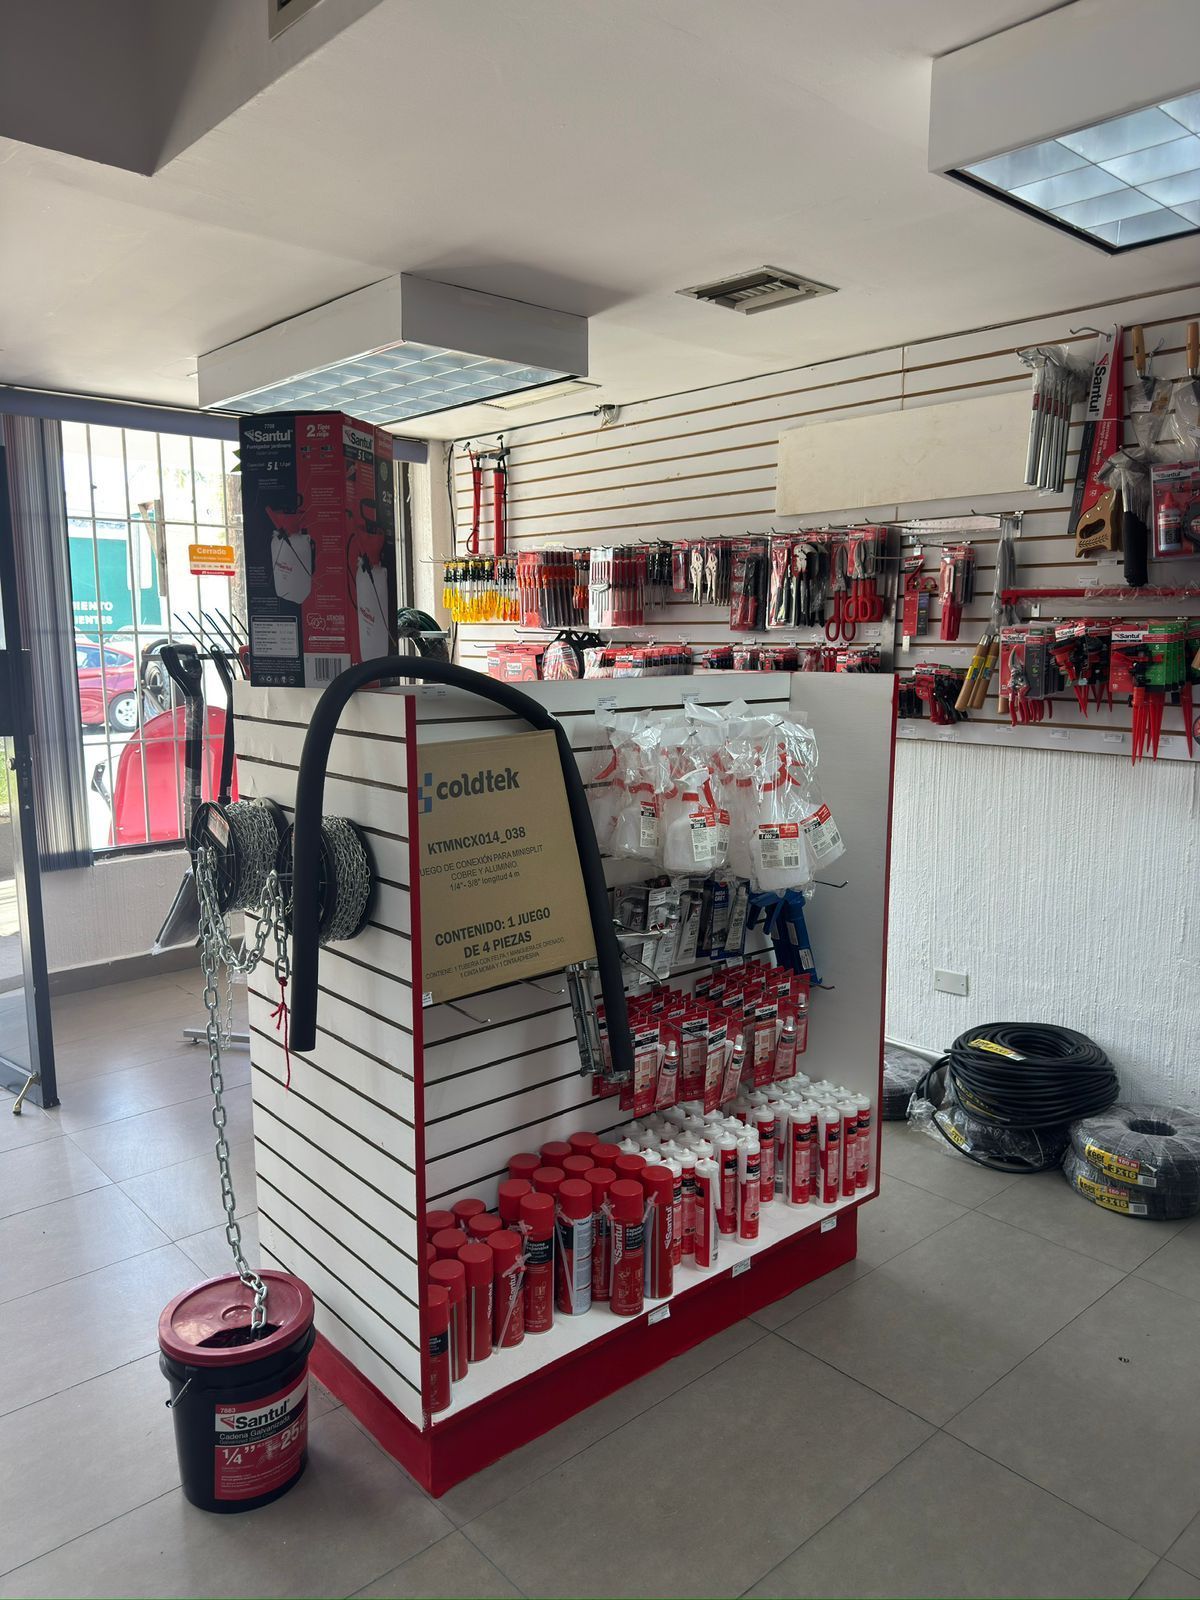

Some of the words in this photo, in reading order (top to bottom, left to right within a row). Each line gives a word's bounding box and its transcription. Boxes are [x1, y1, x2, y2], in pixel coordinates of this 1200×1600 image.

[1089, 366, 1107, 412] Santul
[254, 429, 291, 442] Santul
[306, 424, 316, 438] 2
[350, 432, 372, 450] Santul
[266, 462, 274, 471] 5
[436, 768, 520, 800] coldtek
[428, 826, 526, 855] KTMNCX014_038
[420, 865, 443, 877] UEGO
[444, 862, 455, 874] DE
[456, 853, 493, 869] CONEXIÓN
[493, 850, 512, 862] PARA
[512, 844, 543, 858] MINISPLIT
[451, 868, 478, 882] COBRE
[508, 871, 513, 880] 4
[435, 920, 505, 946] CONTENIDO:
[508, 915, 516, 928] 1
[517, 906, 551, 926] JUEGO
[464, 942, 480, 959] DE
[482, 940, 490, 953] 4
[493, 930, 532, 951] PIEZAS
[1110, 1166, 1137, 1179] 3X16
[1102, 1196, 1128, 1208] 2X16
[220, 1432, 249, 1440] Cadena
[250, 1415, 290, 1437] Galvanizada
[236, 1400, 288, 1430] Santul
[280, 1421, 300, 1450] 25
